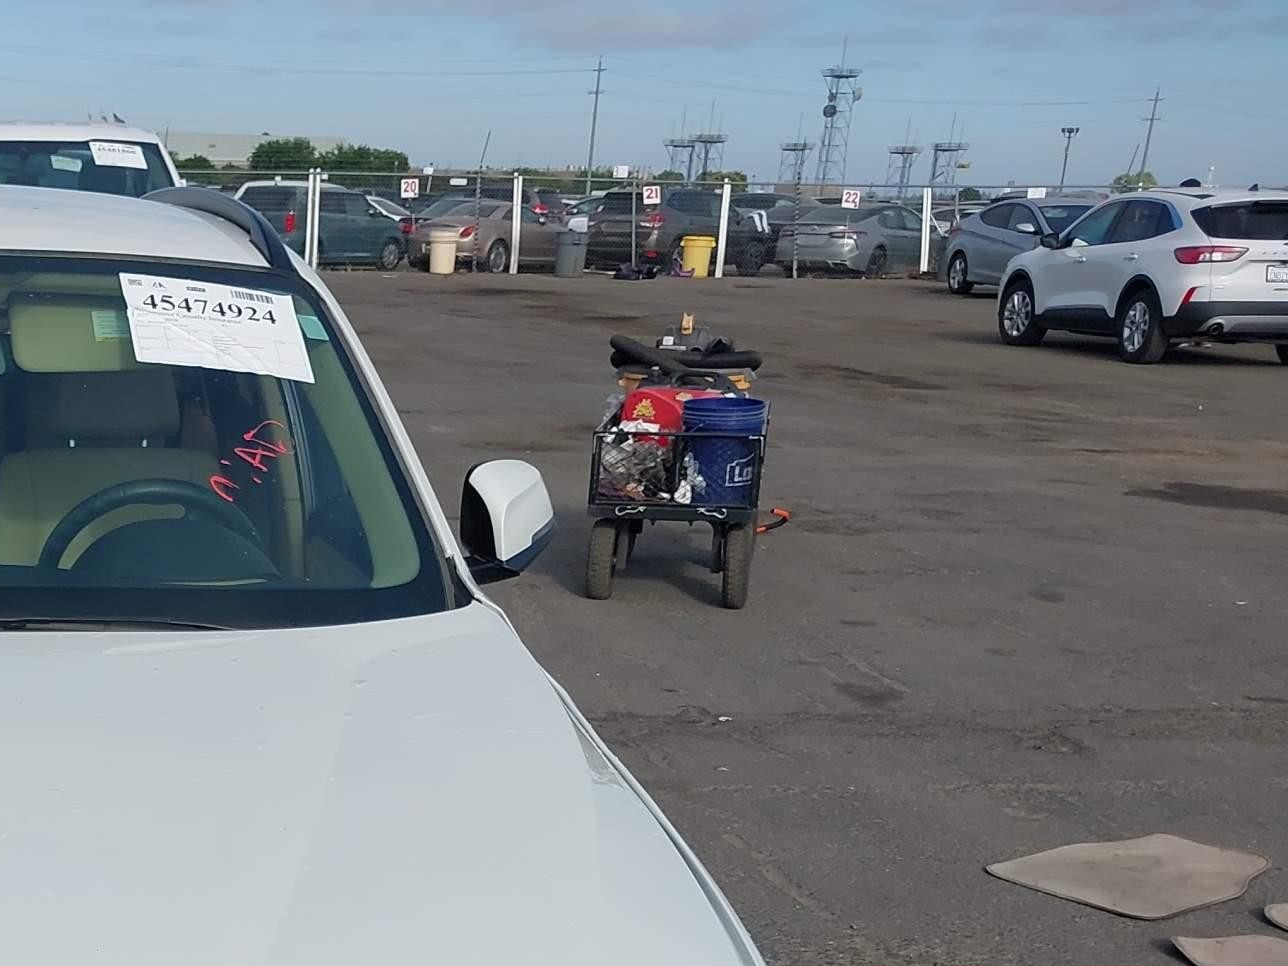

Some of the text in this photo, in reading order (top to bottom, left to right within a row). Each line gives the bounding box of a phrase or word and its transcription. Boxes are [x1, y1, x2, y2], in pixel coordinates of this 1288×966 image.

[403, 181, 417, 193] 20
[645, 187, 659, 199] 21
[844, 191, 858, 203] 22
[142, 294, 278, 325] 45474924
